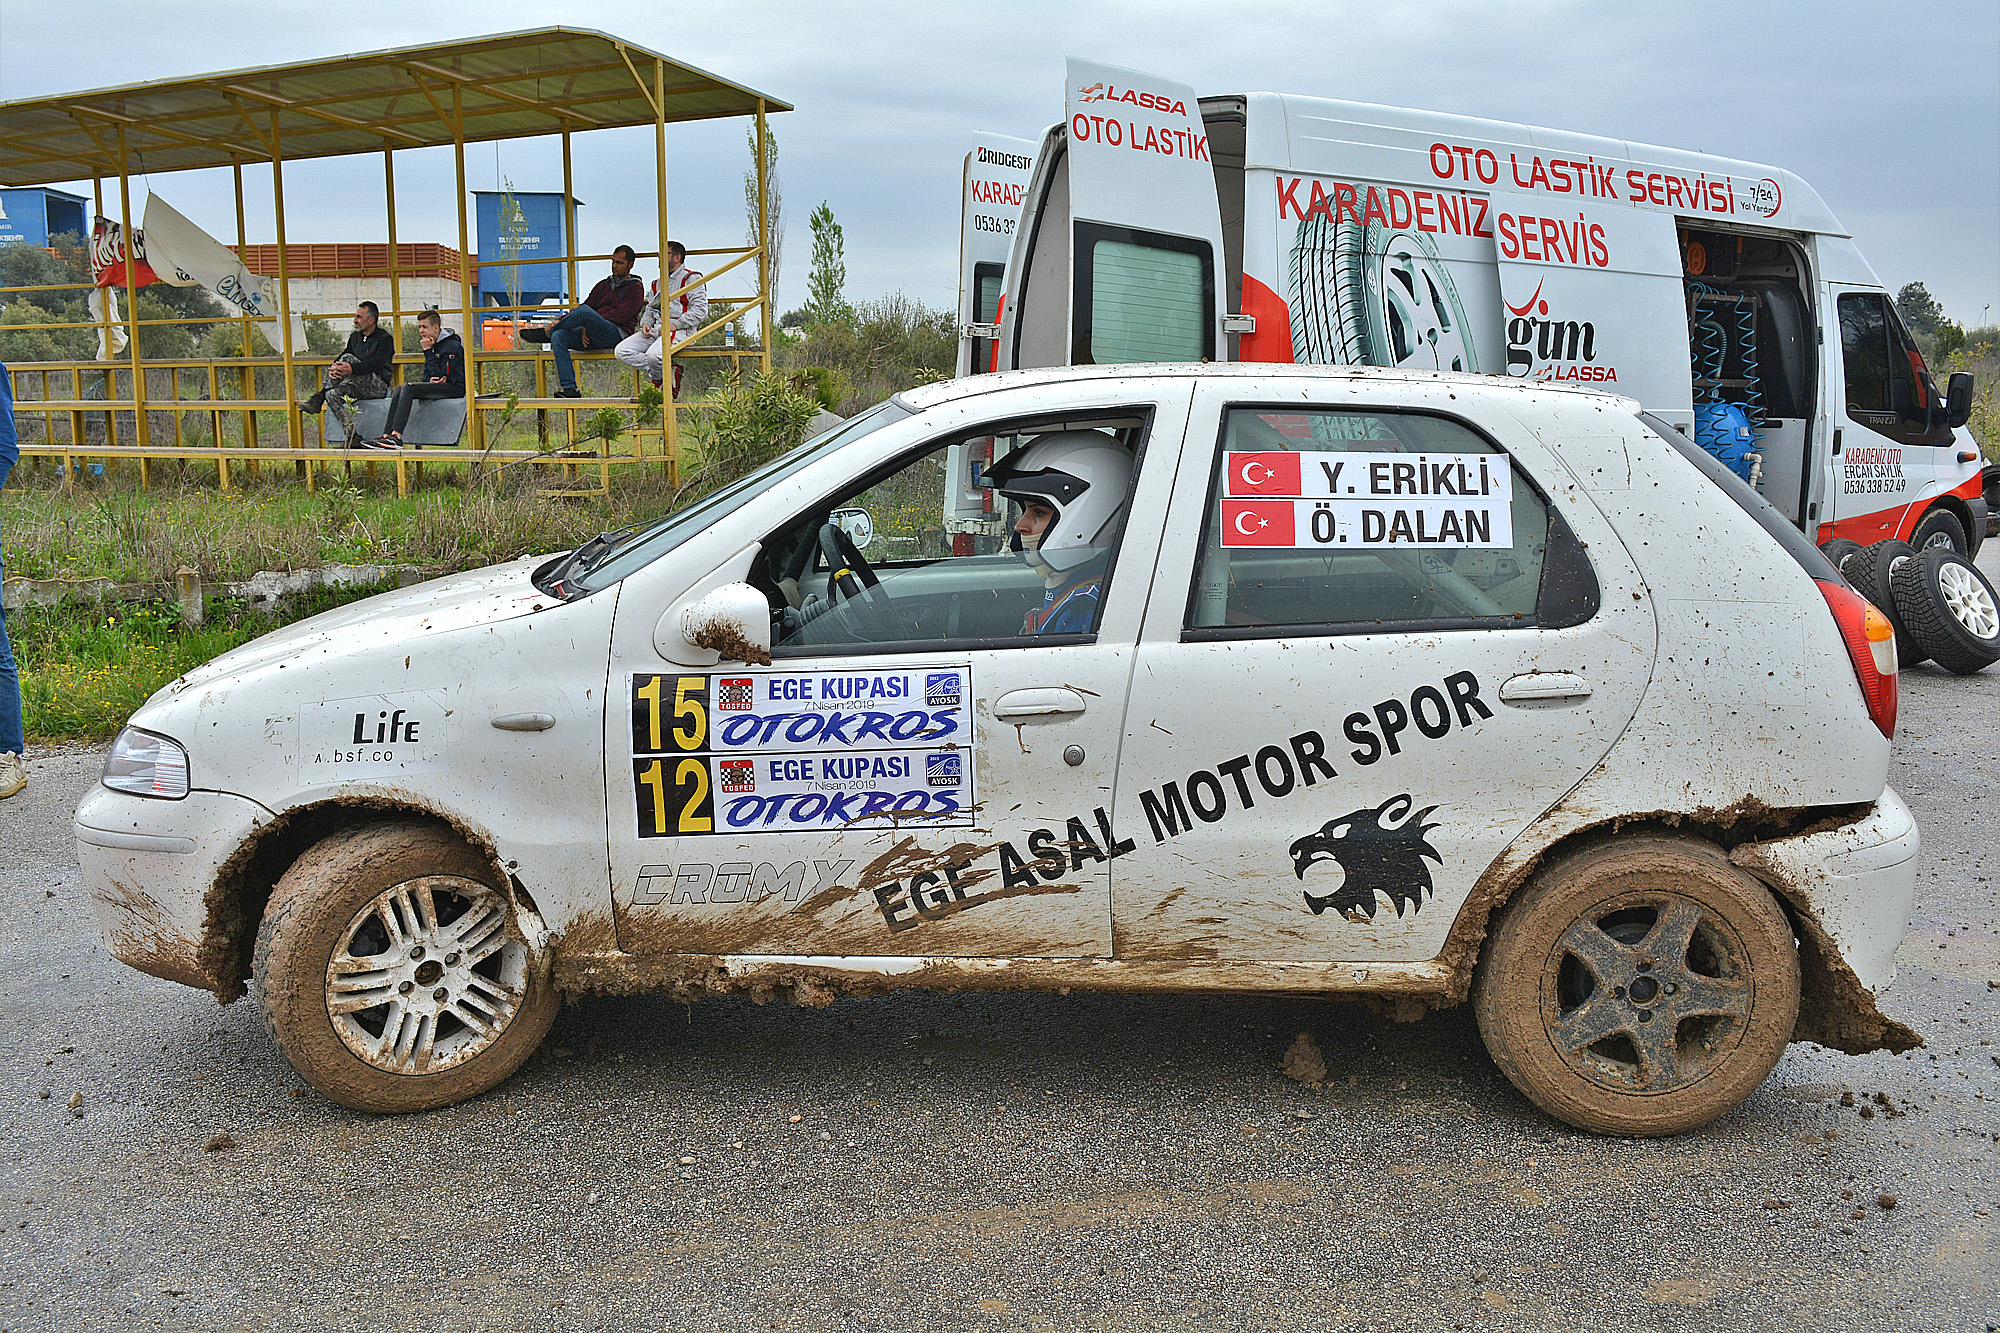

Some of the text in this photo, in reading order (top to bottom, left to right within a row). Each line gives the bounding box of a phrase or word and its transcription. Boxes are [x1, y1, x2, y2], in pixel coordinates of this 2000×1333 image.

[1106, 85, 1187, 116] LASSA
[1073, 113, 1210, 162] OTO LASTİK
[1429, 143, 1735, 214] OTO LASTİK SERVİSİ
[971, 180, 1024, 206] KARAD
[1750, 184, 1773, 203] 7/24
[1740, 201, 1751, 211] Yol
[975, 214, 1001, 234] 0536
[1276, 176, 1494, 239] KARADENİZ
[1498, 212, 1609, 268] SERVİS
[1507, 300, 1597, 376] gim
[1555, 365, 1618, 382] LASSA
[1868, 417, 1896, 425] TRANSIT
[1845, 445, 1902, 464] KARADENİZ OTO
[1320, 456, 1490, 496] Y. ERİKLİ
[1844, 465, 1904, 478] ERCAN SAYLIK
[1844, 479, 1906, 494] 0536 338 52 49
[1311, 502, 1491, 544] Ö. DALAN
[769, 676, 909, 700] EGE KUPASI
[803, 700, 875, 711] 7 Nisan 2019
[930, 696, 958, 705] AYOSK
[638, 676, 707, 751] 15
[716, 707, 962, 747] OTOKROS
[769, 756, 910, 781] EGE KUPASI
[723, 784, 754, 792] TOSFED
[806, 780, 876, 791] 7 Nisan 2019
[931, 777, 958, 785] AYOSK
[640, 758, 712, 834] 12
[875, 670, 1493, 934] EGE ASAL MOTOR SPOR
[720, 790, 964, 828] OTOKROS
